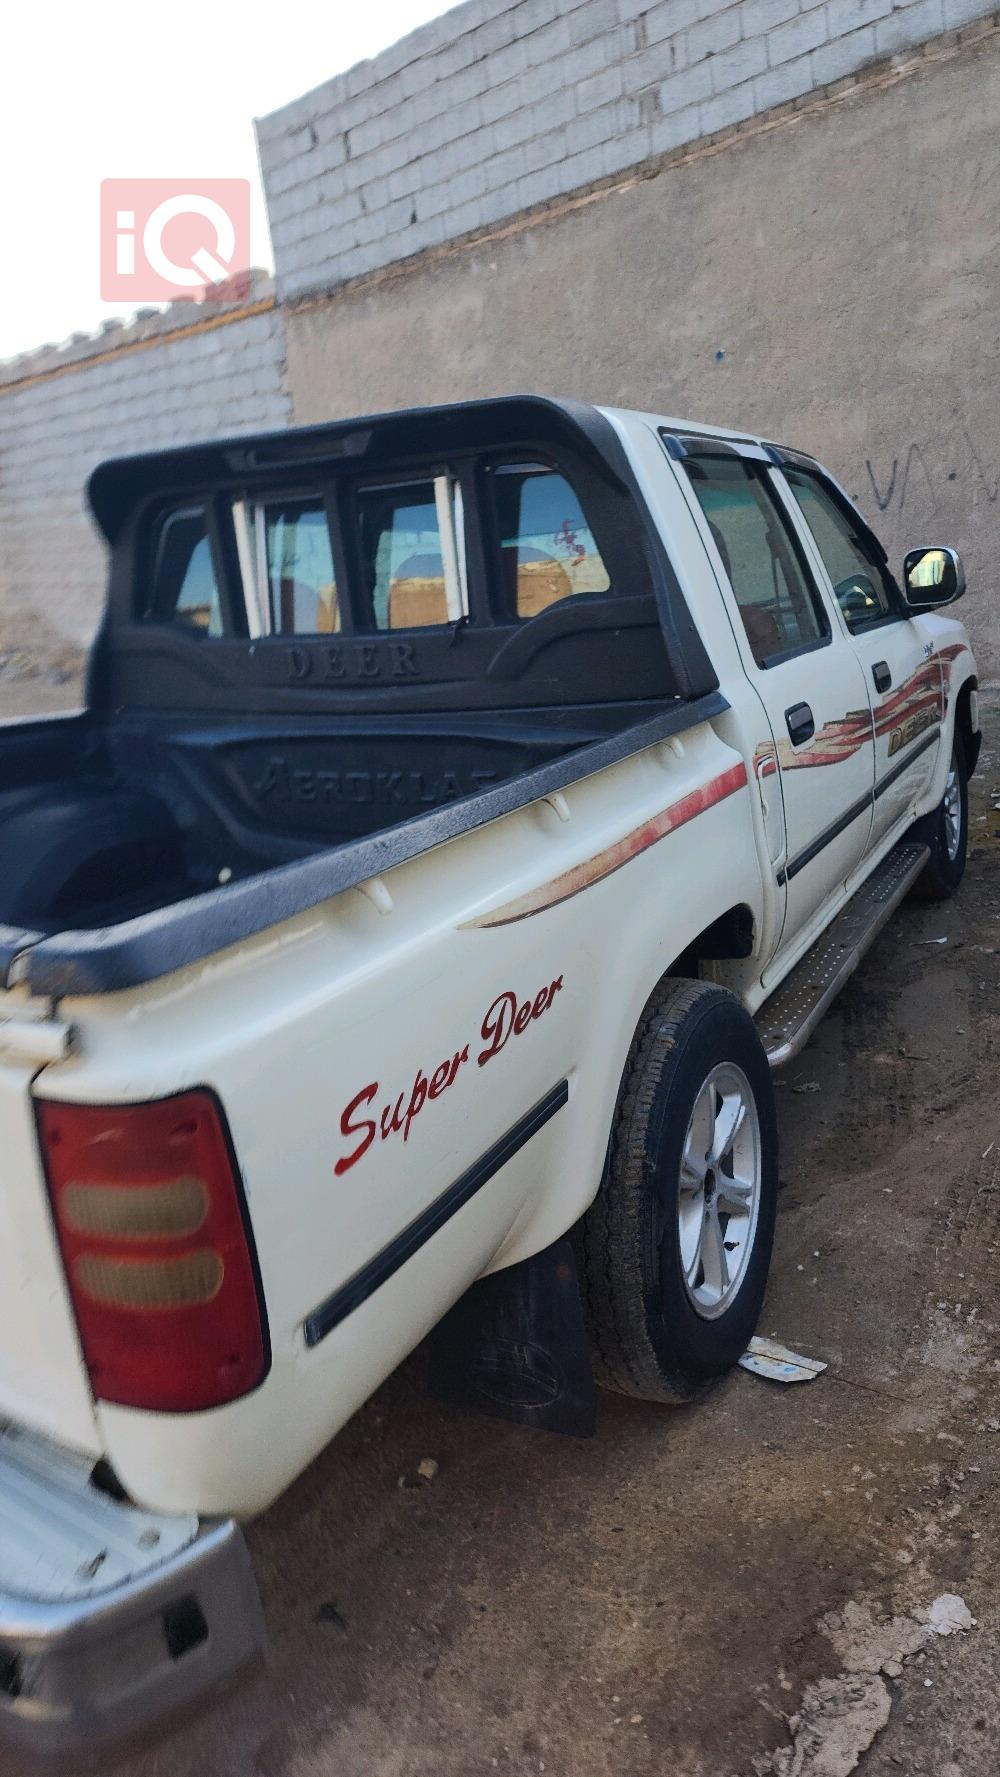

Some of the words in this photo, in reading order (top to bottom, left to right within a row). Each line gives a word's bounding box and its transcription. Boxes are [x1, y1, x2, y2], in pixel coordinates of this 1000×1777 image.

[286, 642, 421, 681] DEER
[333, 1043, 470, 1177] Super
[477, 974, 564, 1068] Deer
